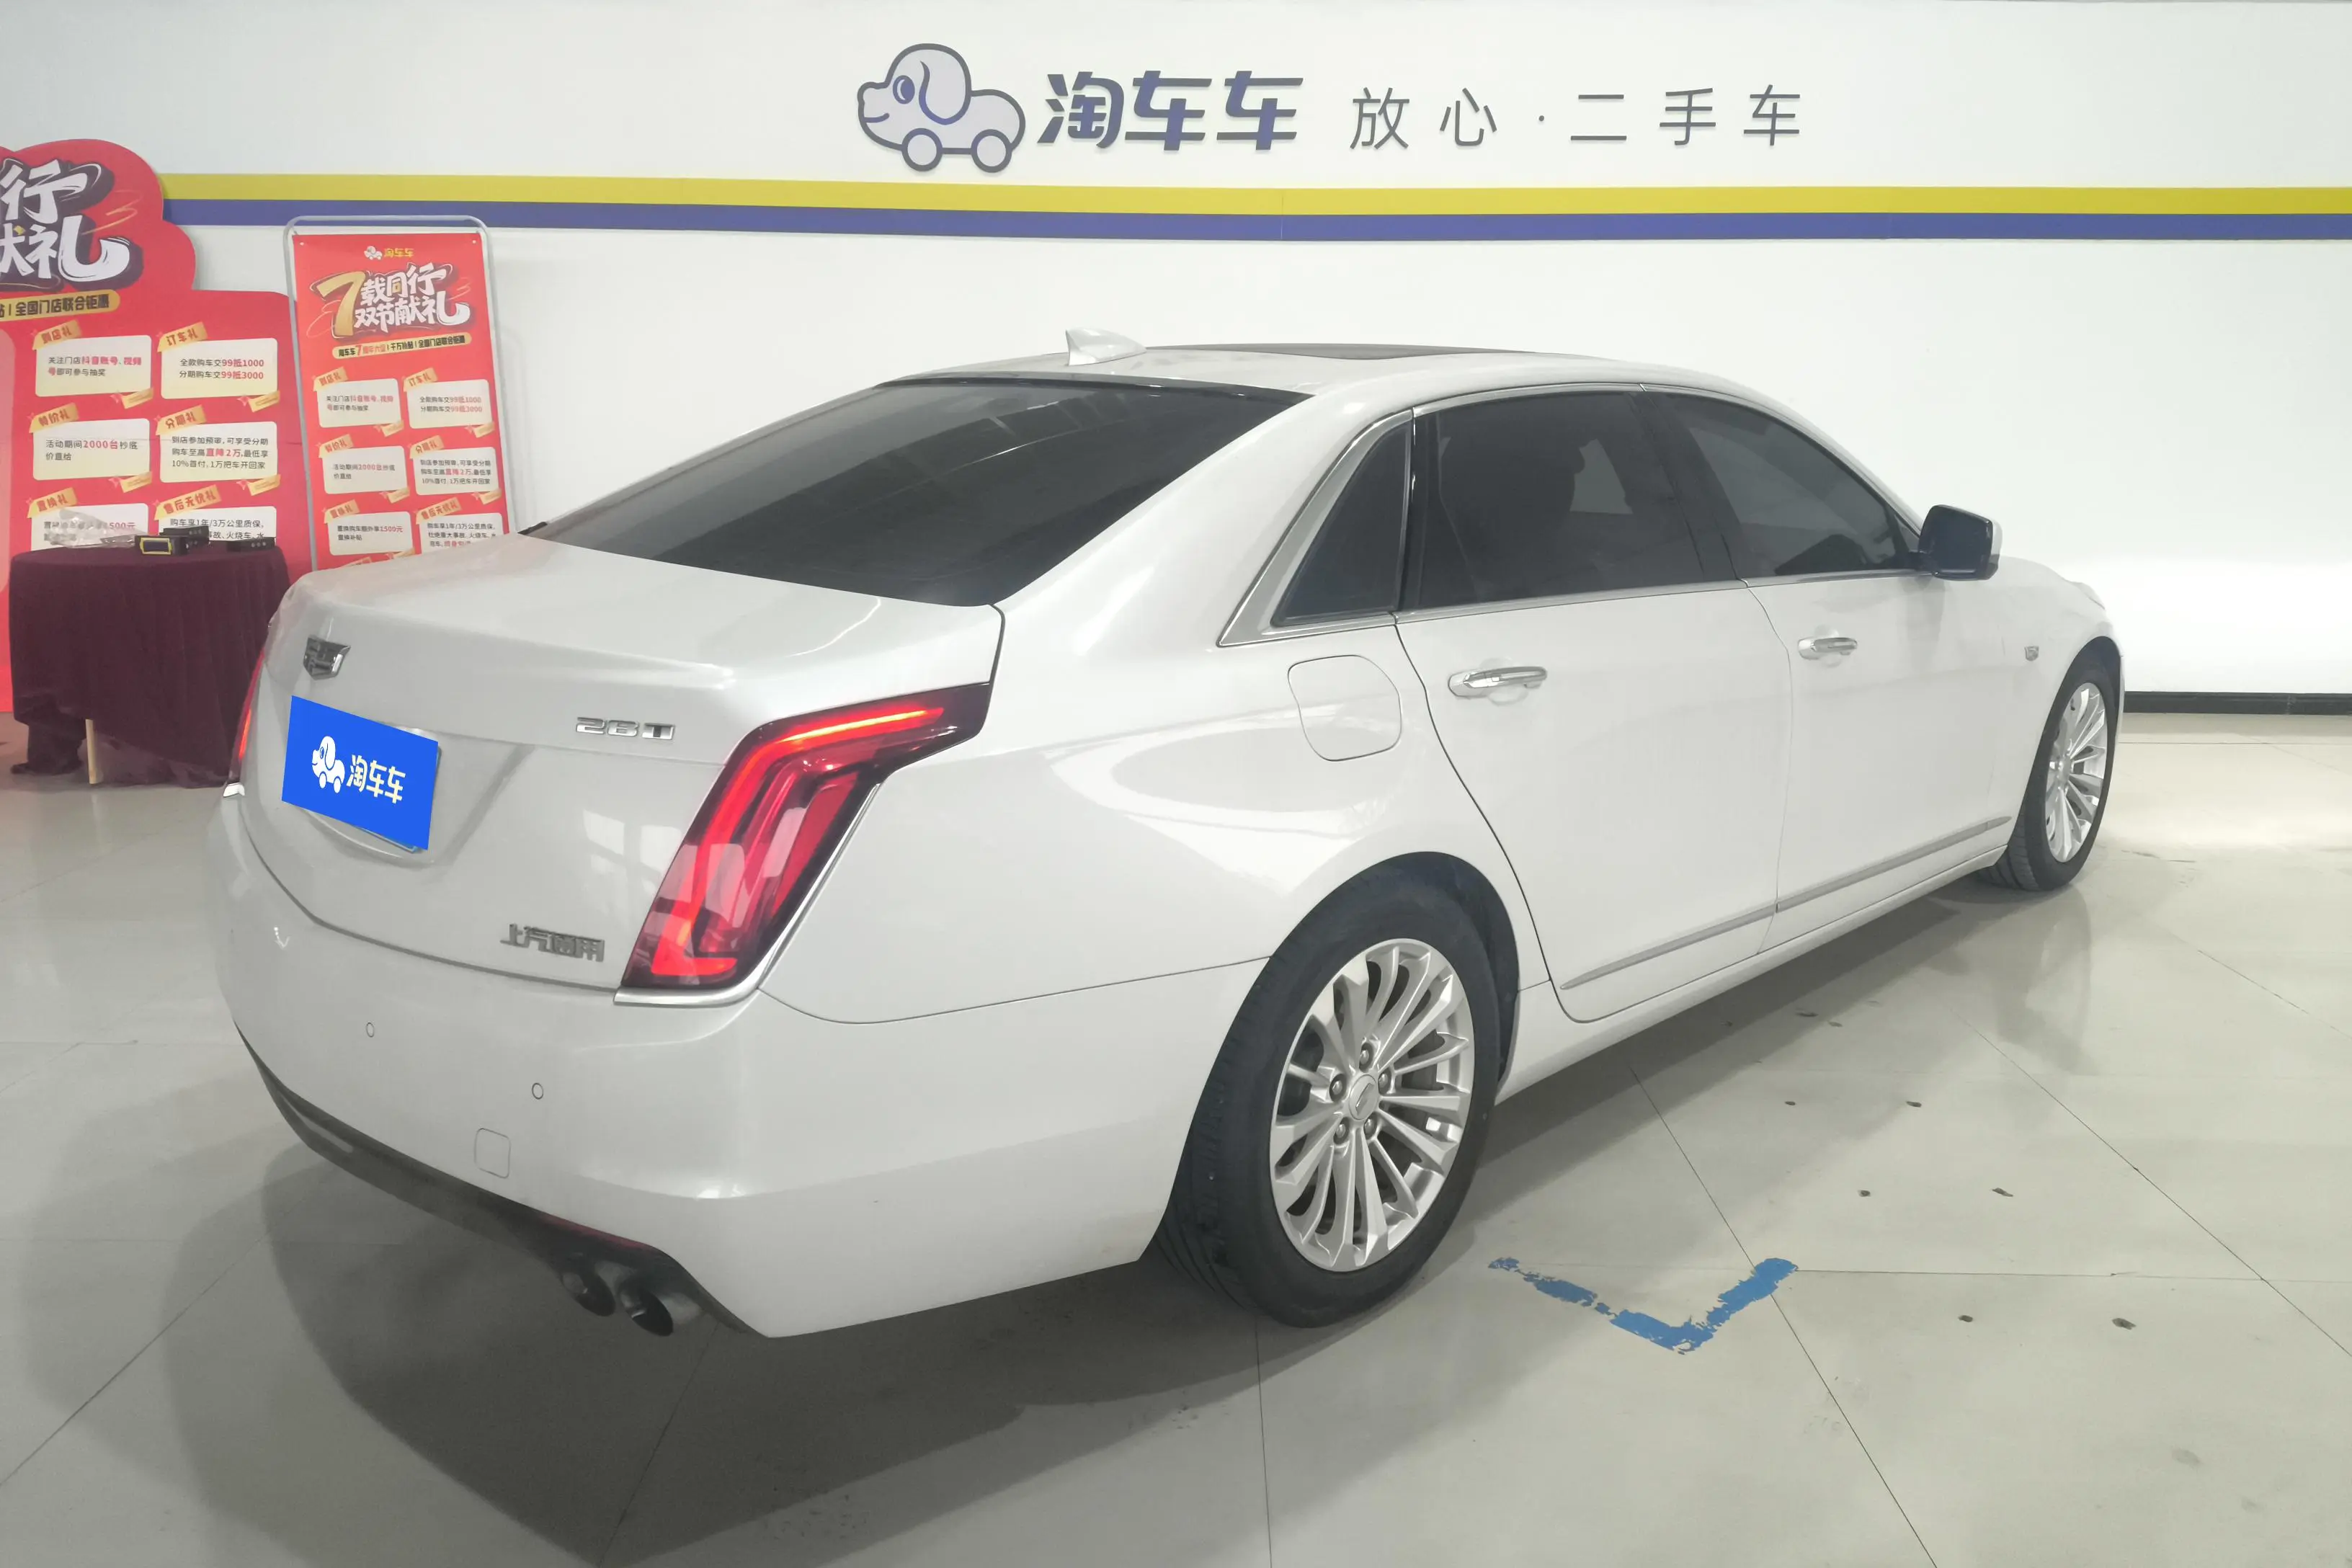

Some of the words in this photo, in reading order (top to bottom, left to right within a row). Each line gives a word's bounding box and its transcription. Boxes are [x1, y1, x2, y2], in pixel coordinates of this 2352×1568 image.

[1037, 71, 1304, 151] 淘车车
[41, 326, 71, 344] 到店礼
[166, 328, 199, 346] 订车礼
[179, 359, 264, 368] 全款购车交99抵1000
[179, 370, 264, 379] 分期购车交99抵3000
[38, 409, 70, 427] 特价礼
[165, 411, 197, 429] 分期礼
[46, 440, 138, 450] 活动期间2000台抄底
[45, 453, 72, 461] 价直给
[164, 489, 217, 514] 售后无忧礼
[576, 716, 675, 740] 28T
